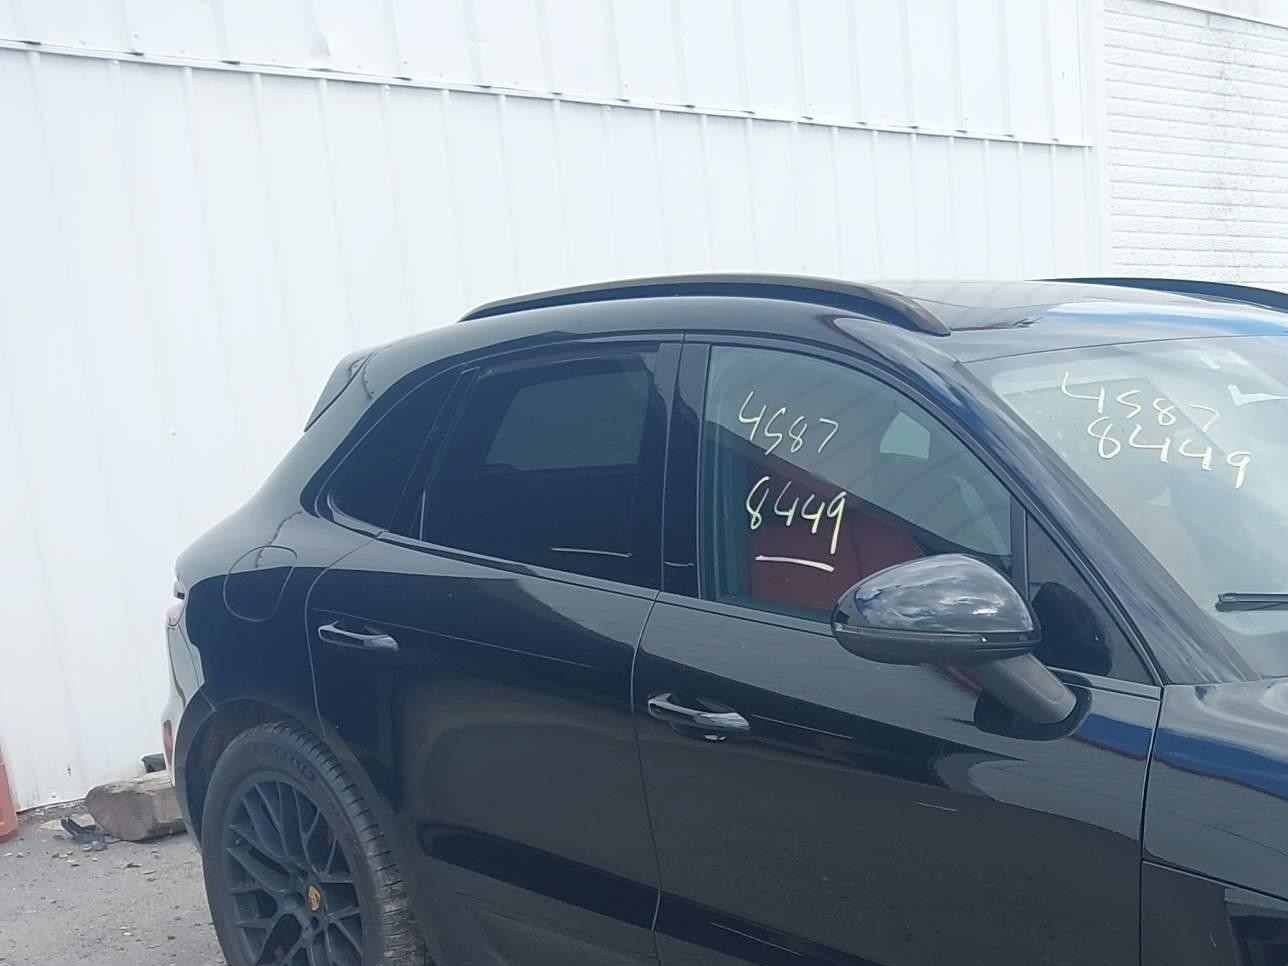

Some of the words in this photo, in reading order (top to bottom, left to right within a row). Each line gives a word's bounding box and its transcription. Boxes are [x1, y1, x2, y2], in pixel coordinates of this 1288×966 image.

[738, 390, 839, 456] 4587
[1061, 371, 1220, 433] 4587
[1087, 416, 1251, 489] 8449
[746, 475, 847, 554] 8449
